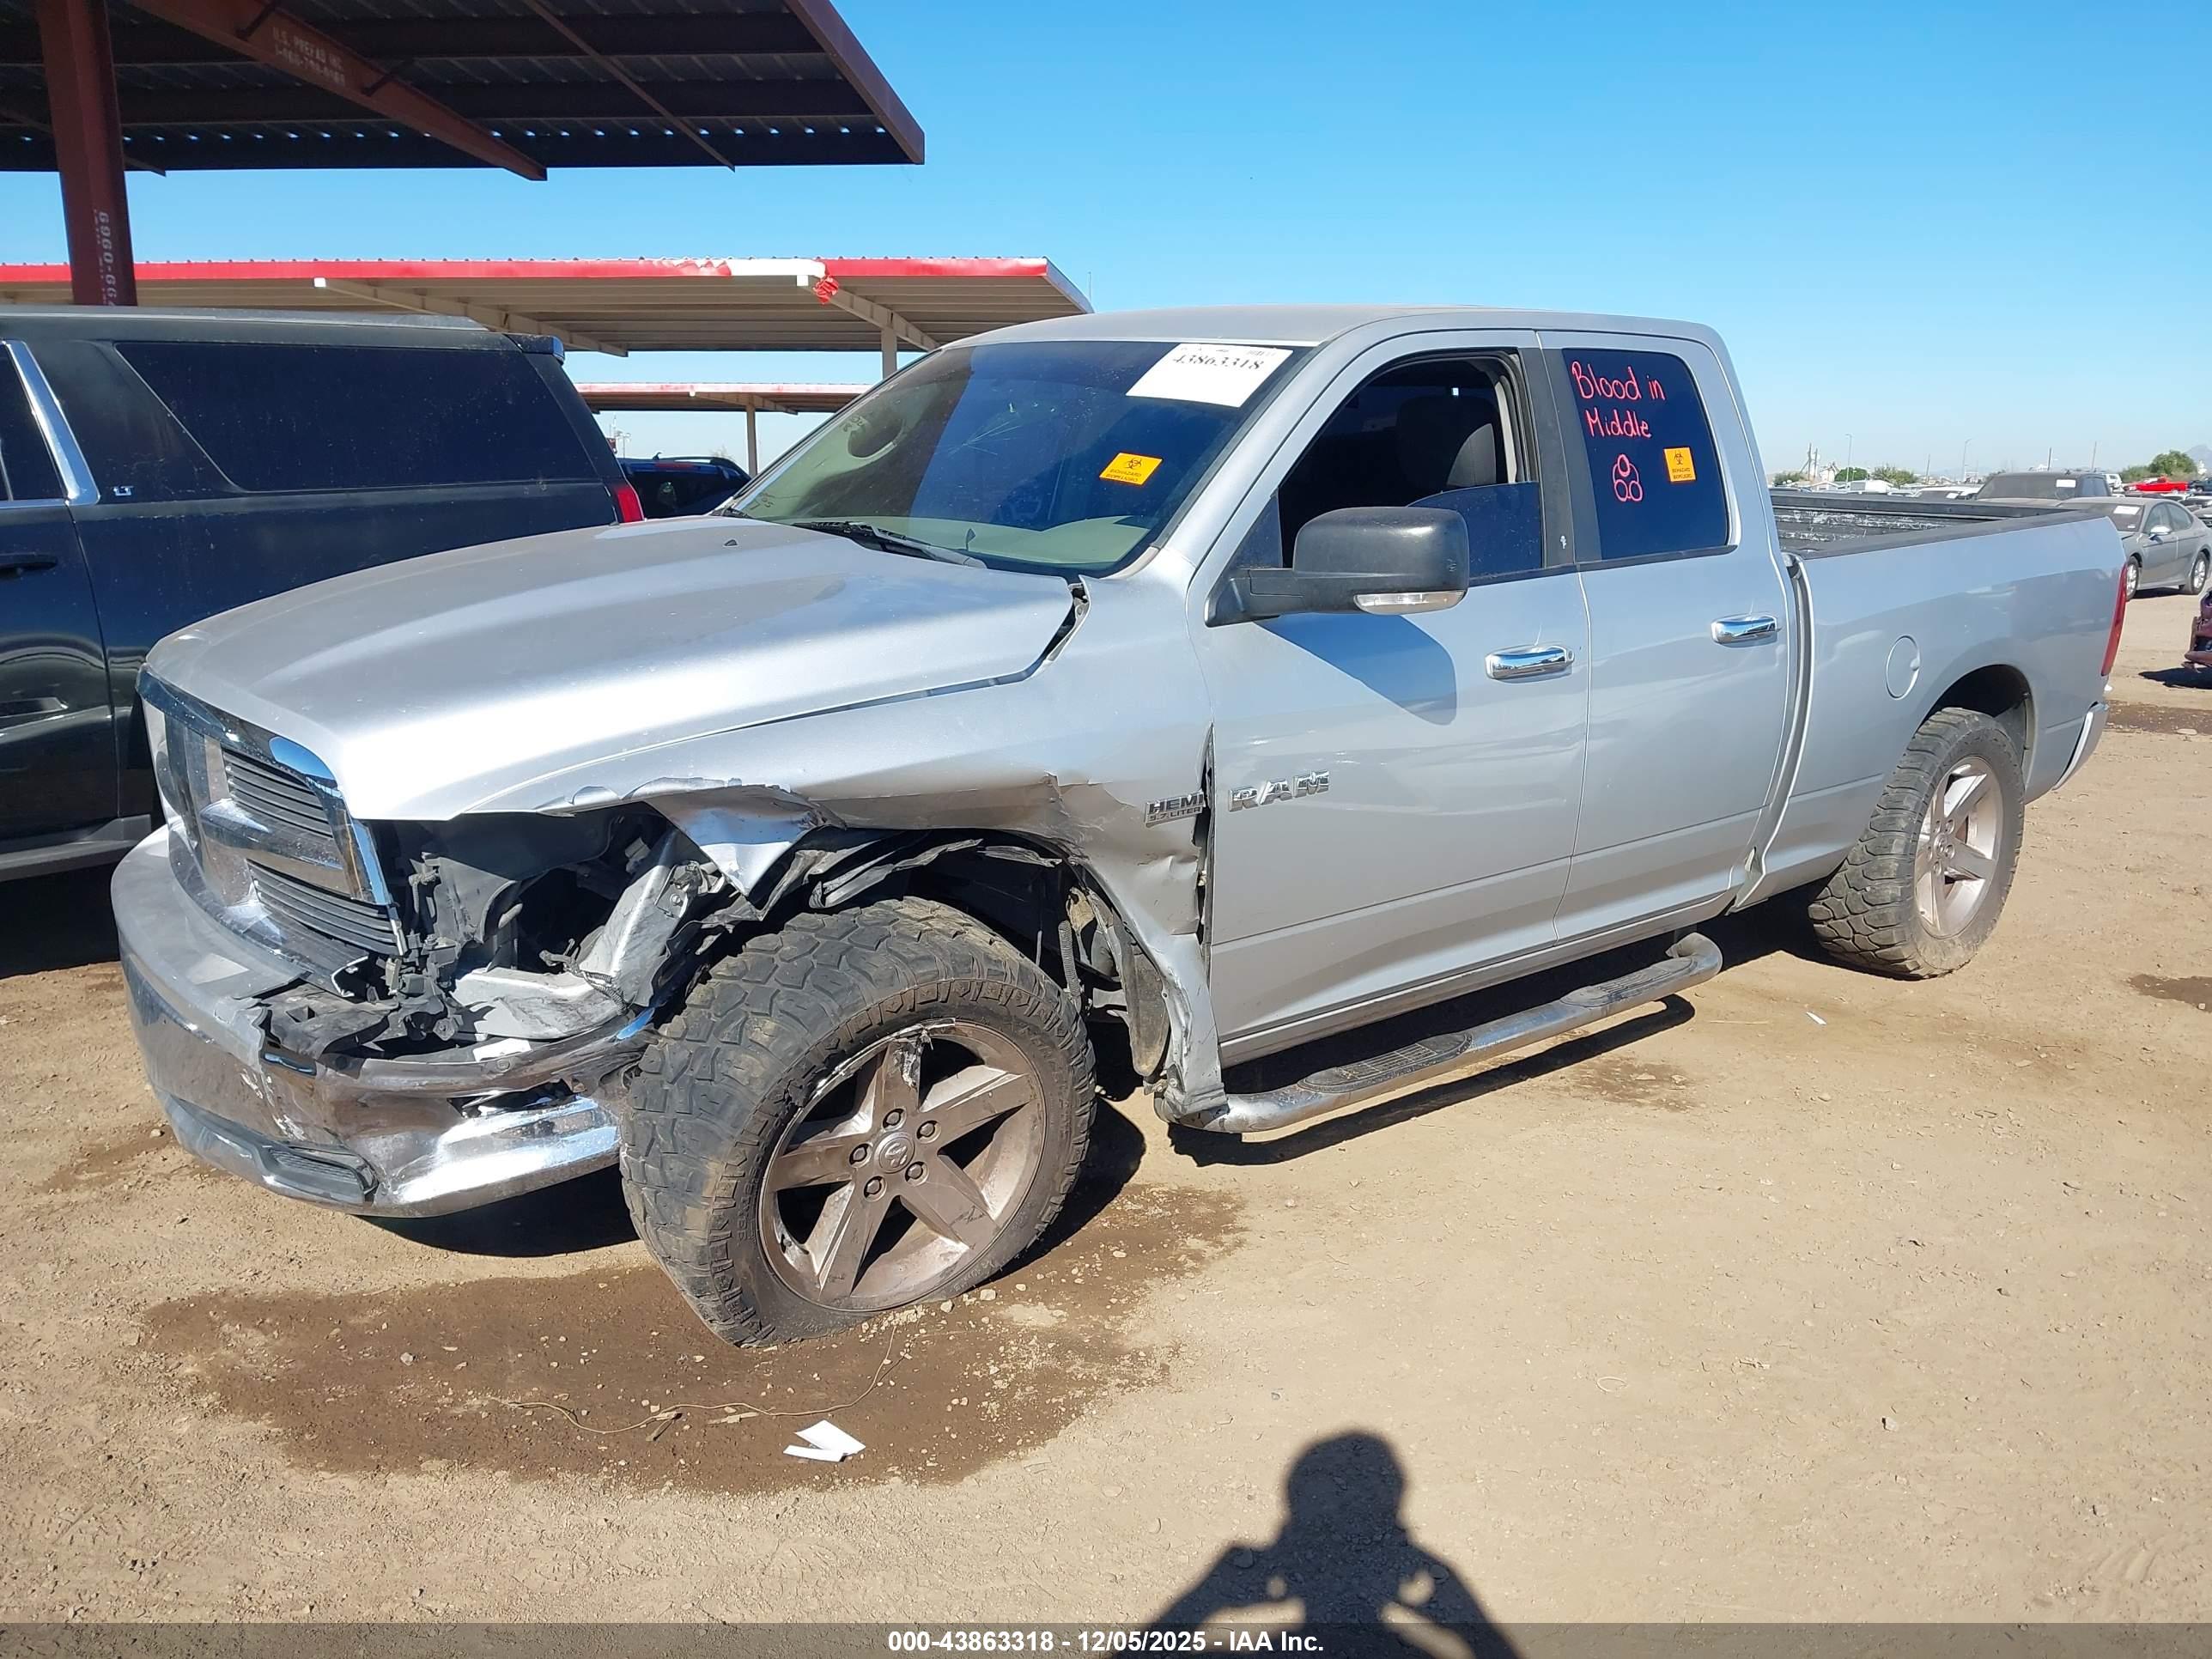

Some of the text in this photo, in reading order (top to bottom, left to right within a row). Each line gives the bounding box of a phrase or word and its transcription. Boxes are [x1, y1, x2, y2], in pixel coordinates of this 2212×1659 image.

[1571, 361, 1666, 400] Blood in
[1585, 407, 1651, 439] Middle
[1149, 793, 1204, 814] HEMI
[1229, 769, 1329, 812] RAM
[1170, 807, 1200, 817] LITER
